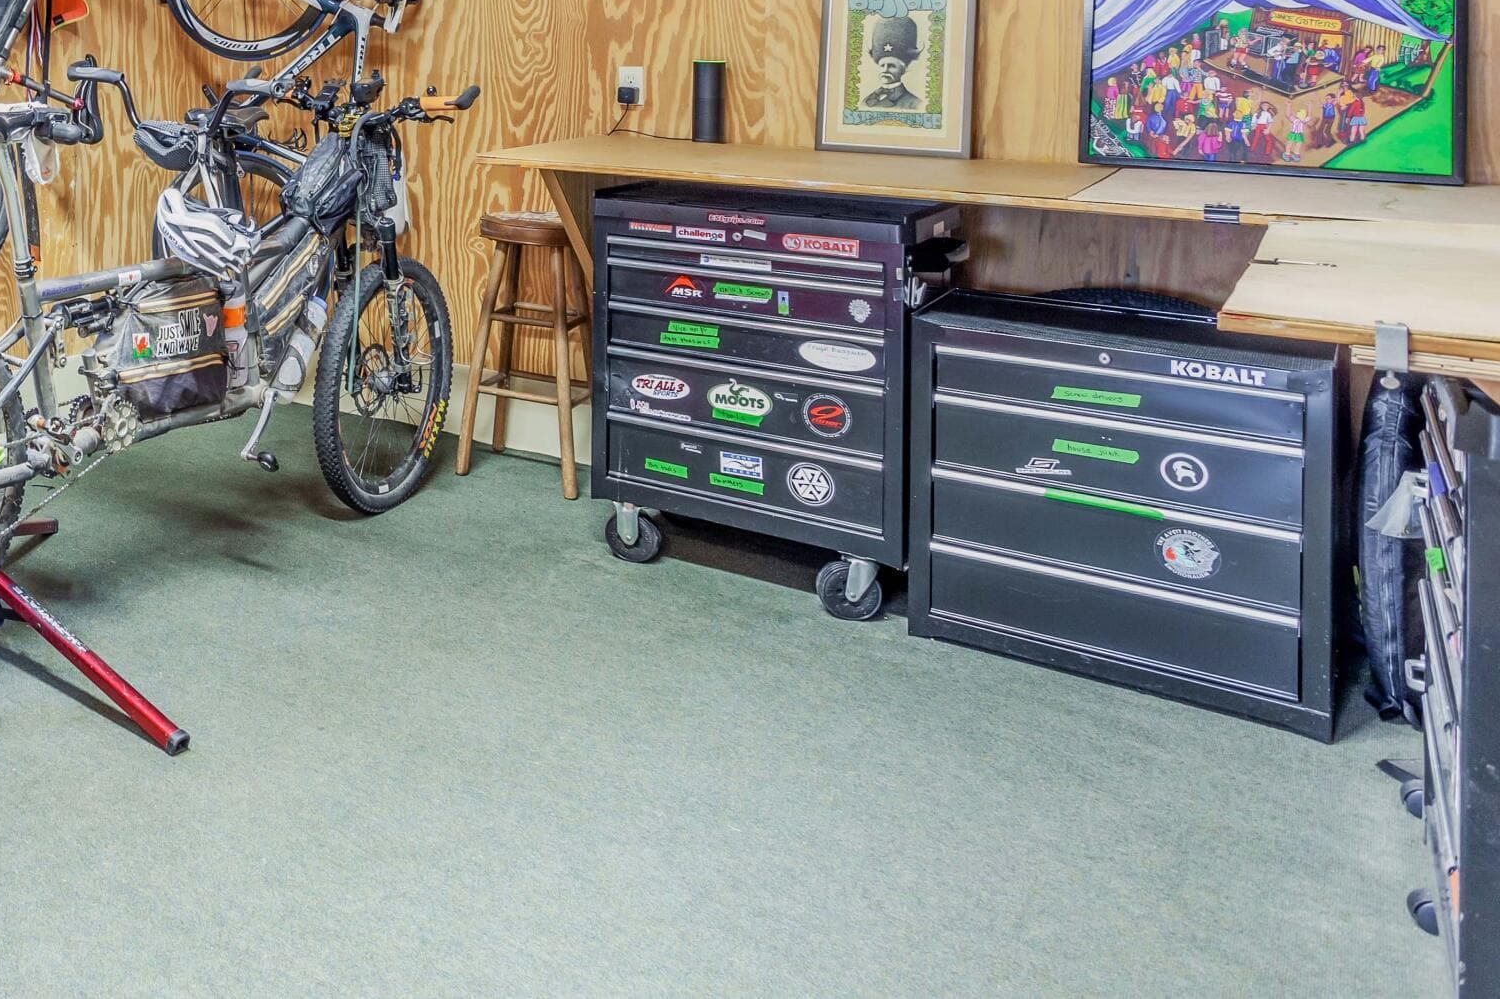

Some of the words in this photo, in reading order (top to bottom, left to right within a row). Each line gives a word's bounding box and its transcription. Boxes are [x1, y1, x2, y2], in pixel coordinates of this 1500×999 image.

[678, 229, 724, 241] challenge
[803, 239, 855, 253] KOBALT
[671, 286, 703, 298] MSR
[157, 325, 180, 341] JUST
[179, 309, 200, 338] SMILE
[157, 340, 178, 356] AND
[178, 336, 199, 353] WAVE
[1170, 359, 1267, 387] KOBALT
[636, 378, 653, 390] TRI
[655, 379, 676, 392] ALL
[676, 383, 685, 393] 3
[652, 389, 678, 398] SPORTS
[714, 393, 765, 410] MOOTS
